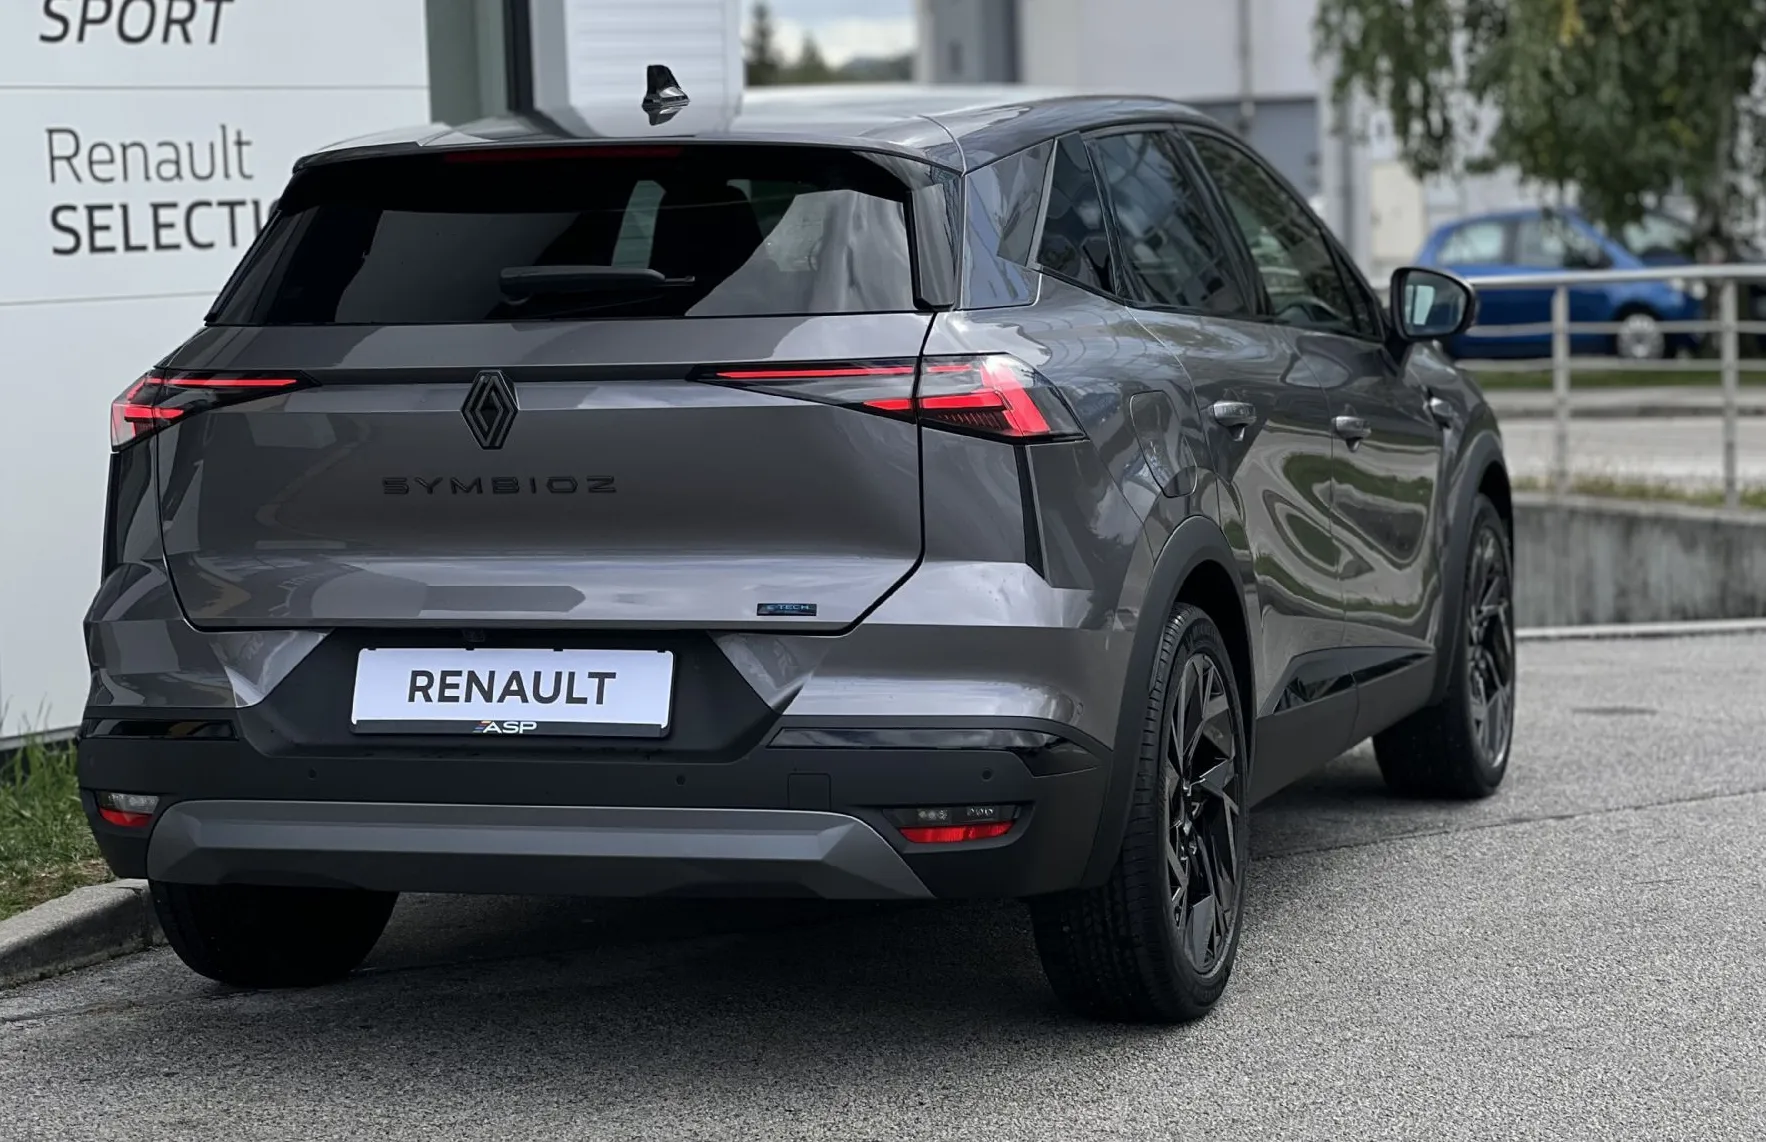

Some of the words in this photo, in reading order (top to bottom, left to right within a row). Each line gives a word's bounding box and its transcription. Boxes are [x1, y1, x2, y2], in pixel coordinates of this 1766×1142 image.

[39, 0, 234, 44] SPORT
[45, 124, 253, 184] Renault
[50, 199, 281, 255] SELECTI
[382, 475, 617, 495] SYMBIOZ
[407, 669, 617, 705] RENAULT
[483, 721, 537, 734] ASP
